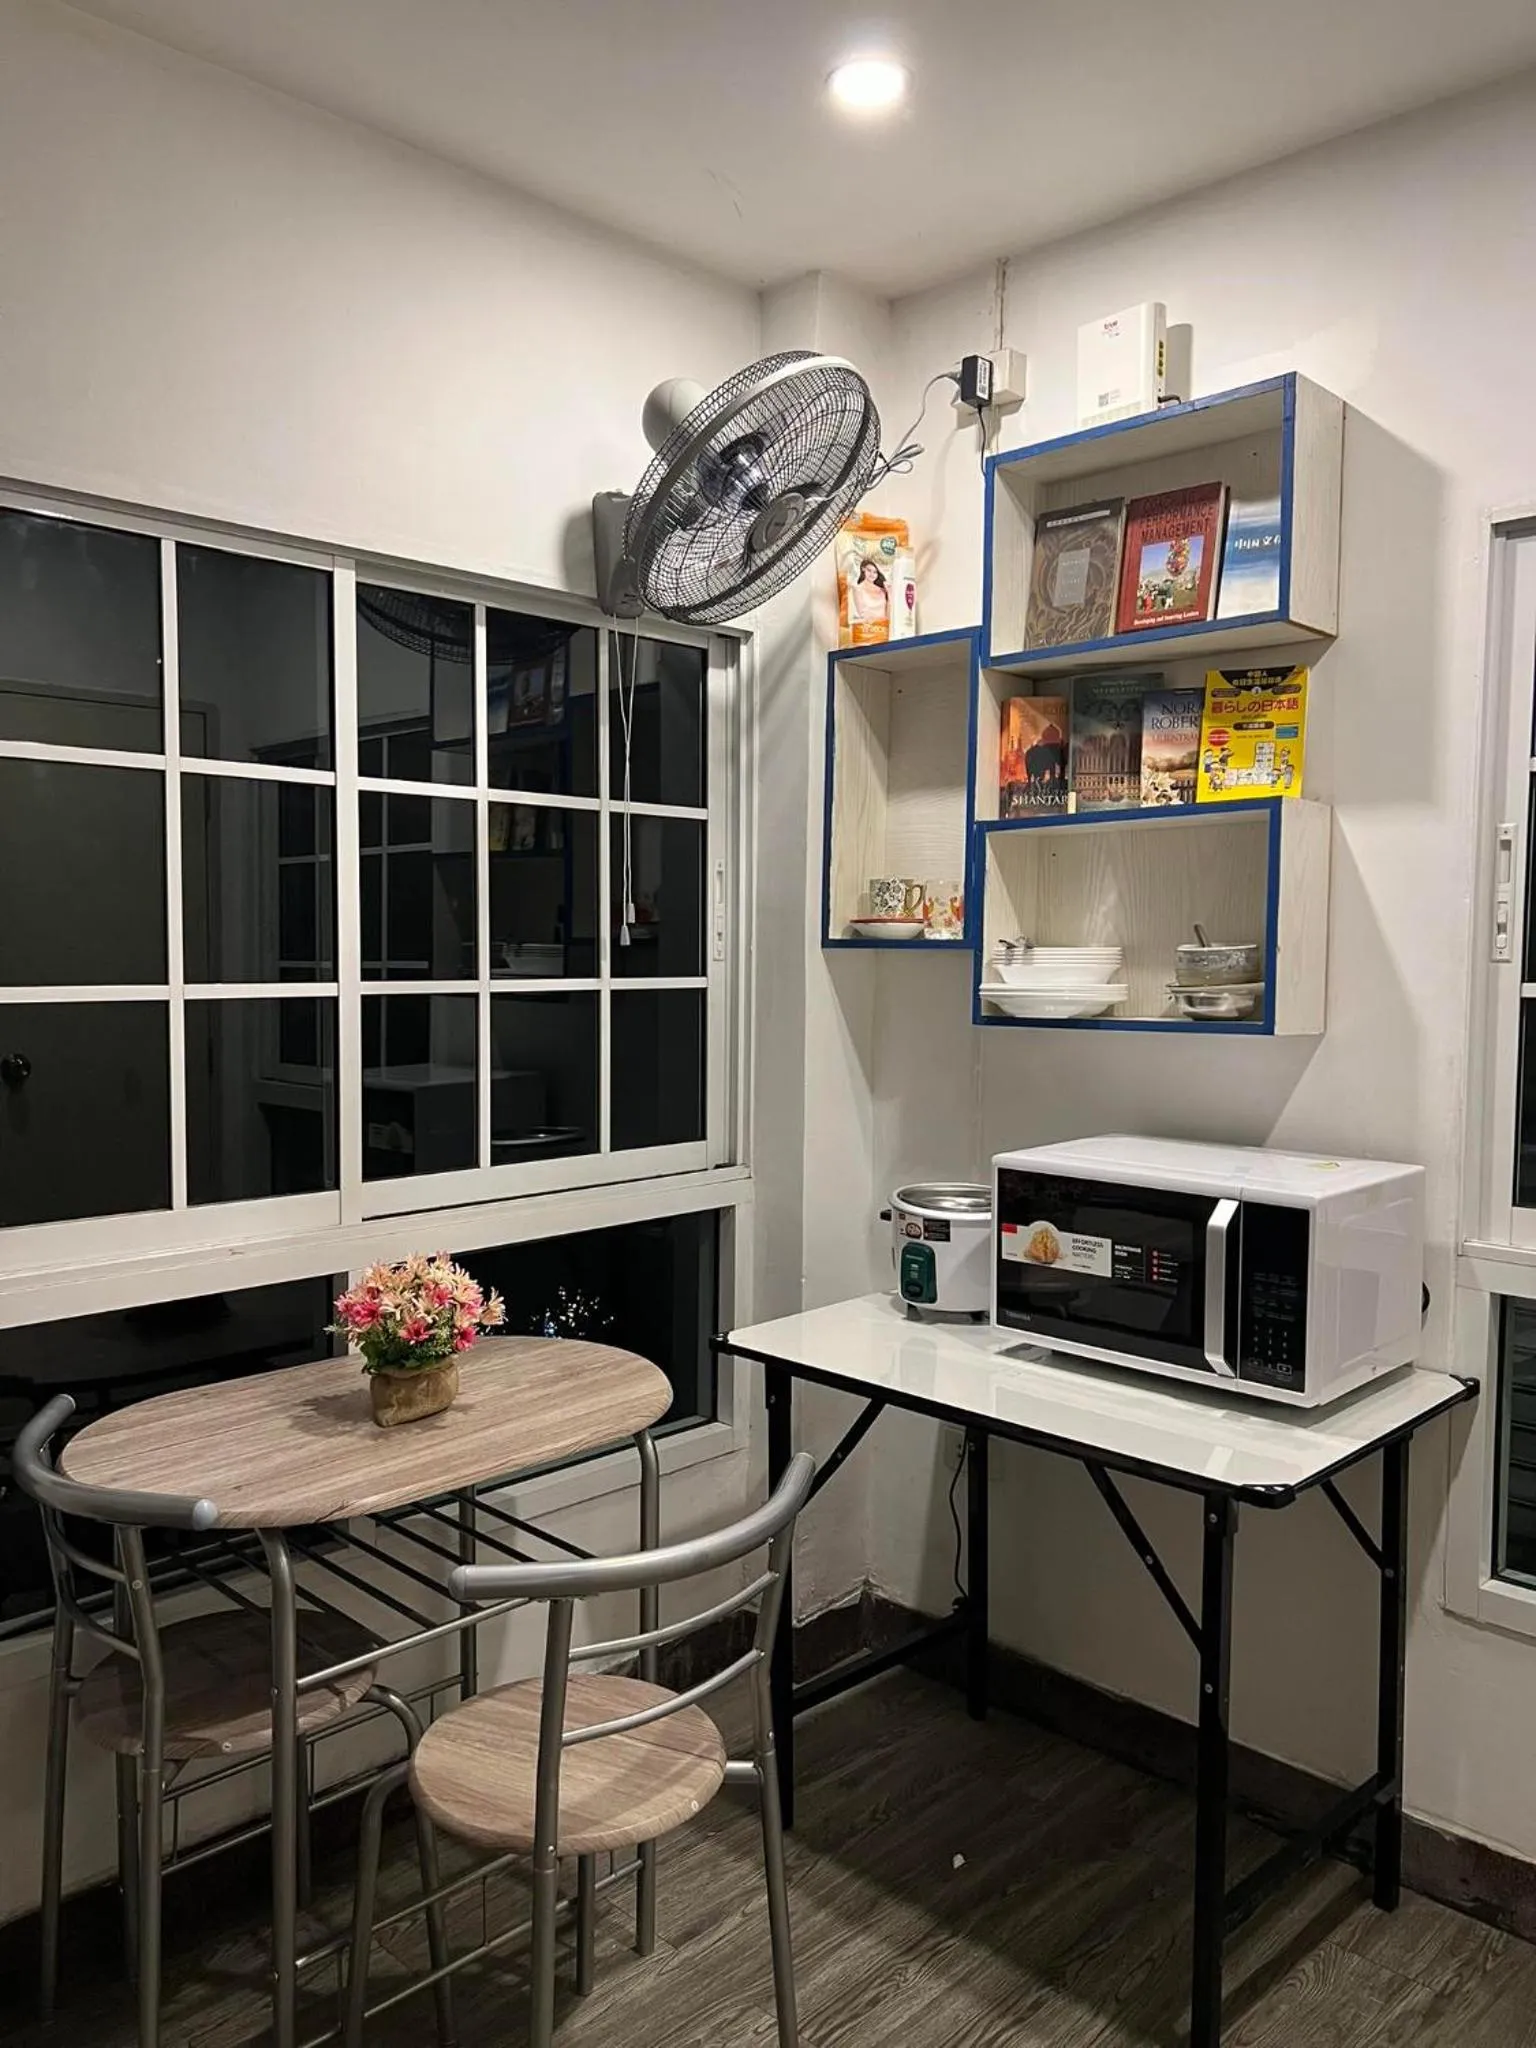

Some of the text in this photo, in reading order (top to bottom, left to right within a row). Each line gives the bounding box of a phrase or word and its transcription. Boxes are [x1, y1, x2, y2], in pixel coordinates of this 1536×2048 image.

[1139, 501, 1215, 528] PERFORMANCE
[1141, 517, 1210, 541] MANAGEMENT
[1071, 1237, 1104, 1248] EFFORTLESS
[1071, 1244, 1097, 1254] COOKING
